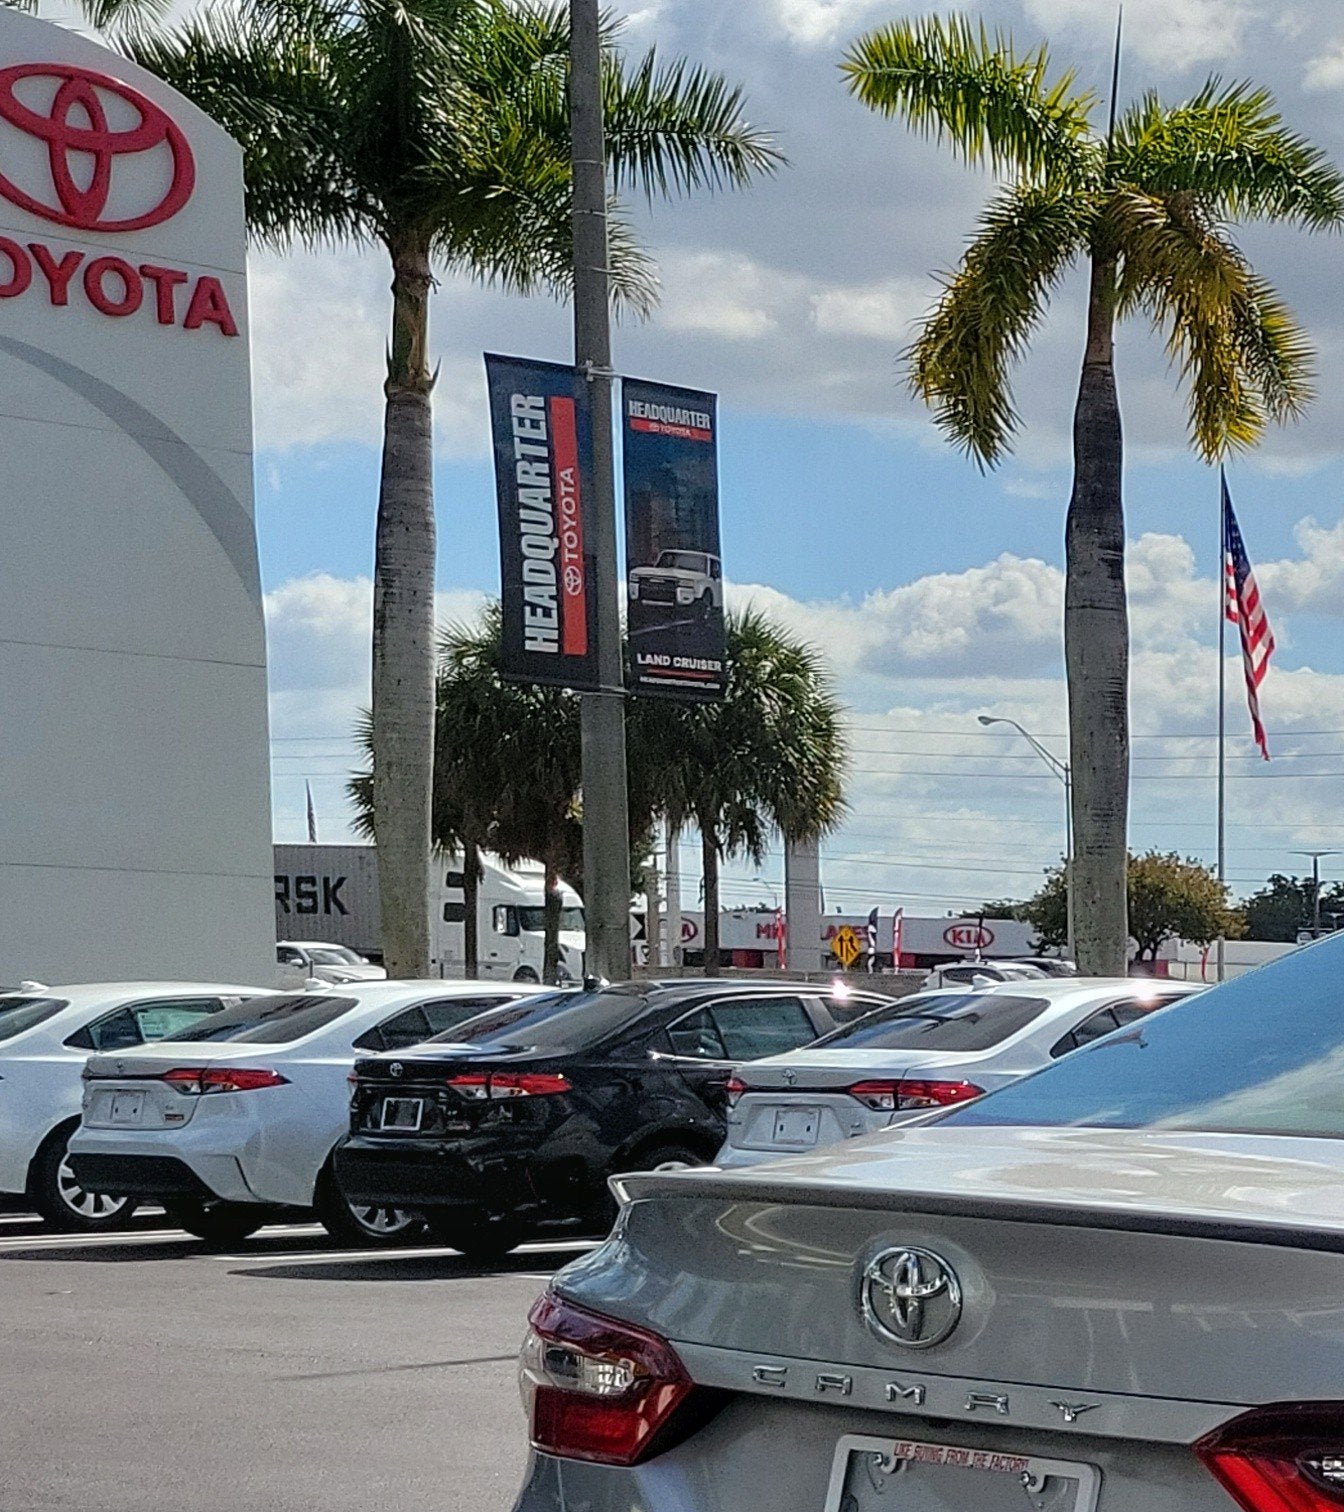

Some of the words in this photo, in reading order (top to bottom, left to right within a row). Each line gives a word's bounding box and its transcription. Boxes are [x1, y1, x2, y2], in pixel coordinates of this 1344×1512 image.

[629, 400, 711, 429] HEADQUARTER
[510, 393, 559, 653] HEADQUARTER
[561, 467, 578, 562] TOYOTA
[637, 653, 671, 666] LAND
[673, 657, 721, 671] CRUISER
